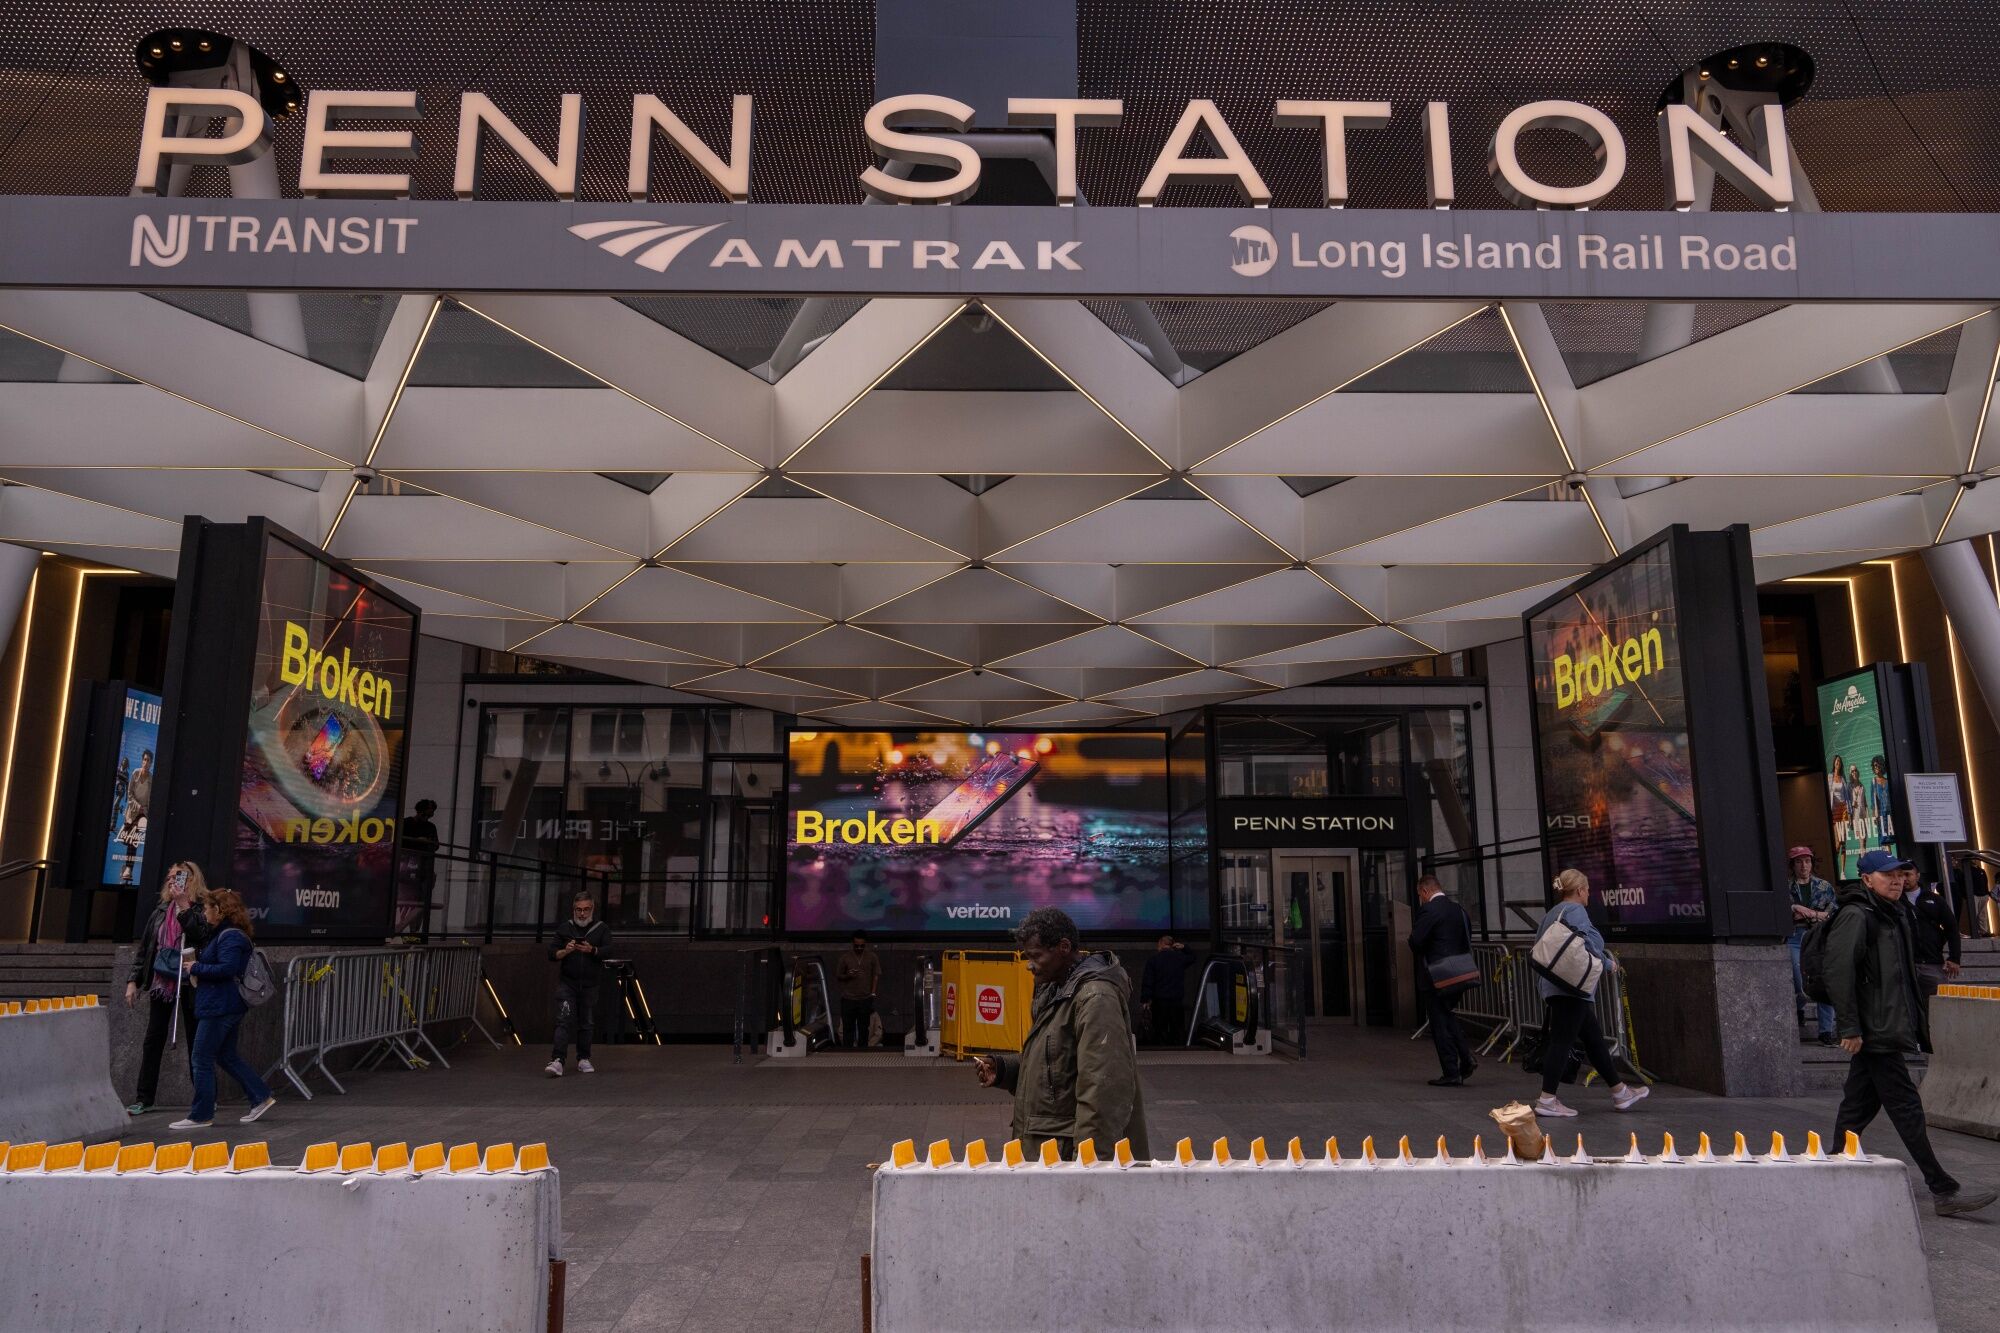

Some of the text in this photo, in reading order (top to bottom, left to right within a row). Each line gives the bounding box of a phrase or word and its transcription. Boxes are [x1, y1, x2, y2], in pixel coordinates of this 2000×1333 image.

[135, 86, 1798, 206] PENN STATION
[196, 214, 419, 256] TRANSIT
[710, 237, 1084, 272] AMTRAK
[1291, 231, 1798, 280] Long Island Rail Road
[280, 620, 393, 720] Broken
[1554, 627, 1665, 710] Broken
[125, 696, 140, 720] WE
[796, 809, 942, 846] Broken
[1234, 816, 1395, 831] PENN STATION
[1833, 820, 1852, 842] WE
[1852, 817, 1879, 840] LOVE
[1879, 814, 1895, 837] LA
[295, 884, 341, 909] verizon
[946, 903, 1011, 919] verizon
[1601, 884, 1646, 907] verizon
